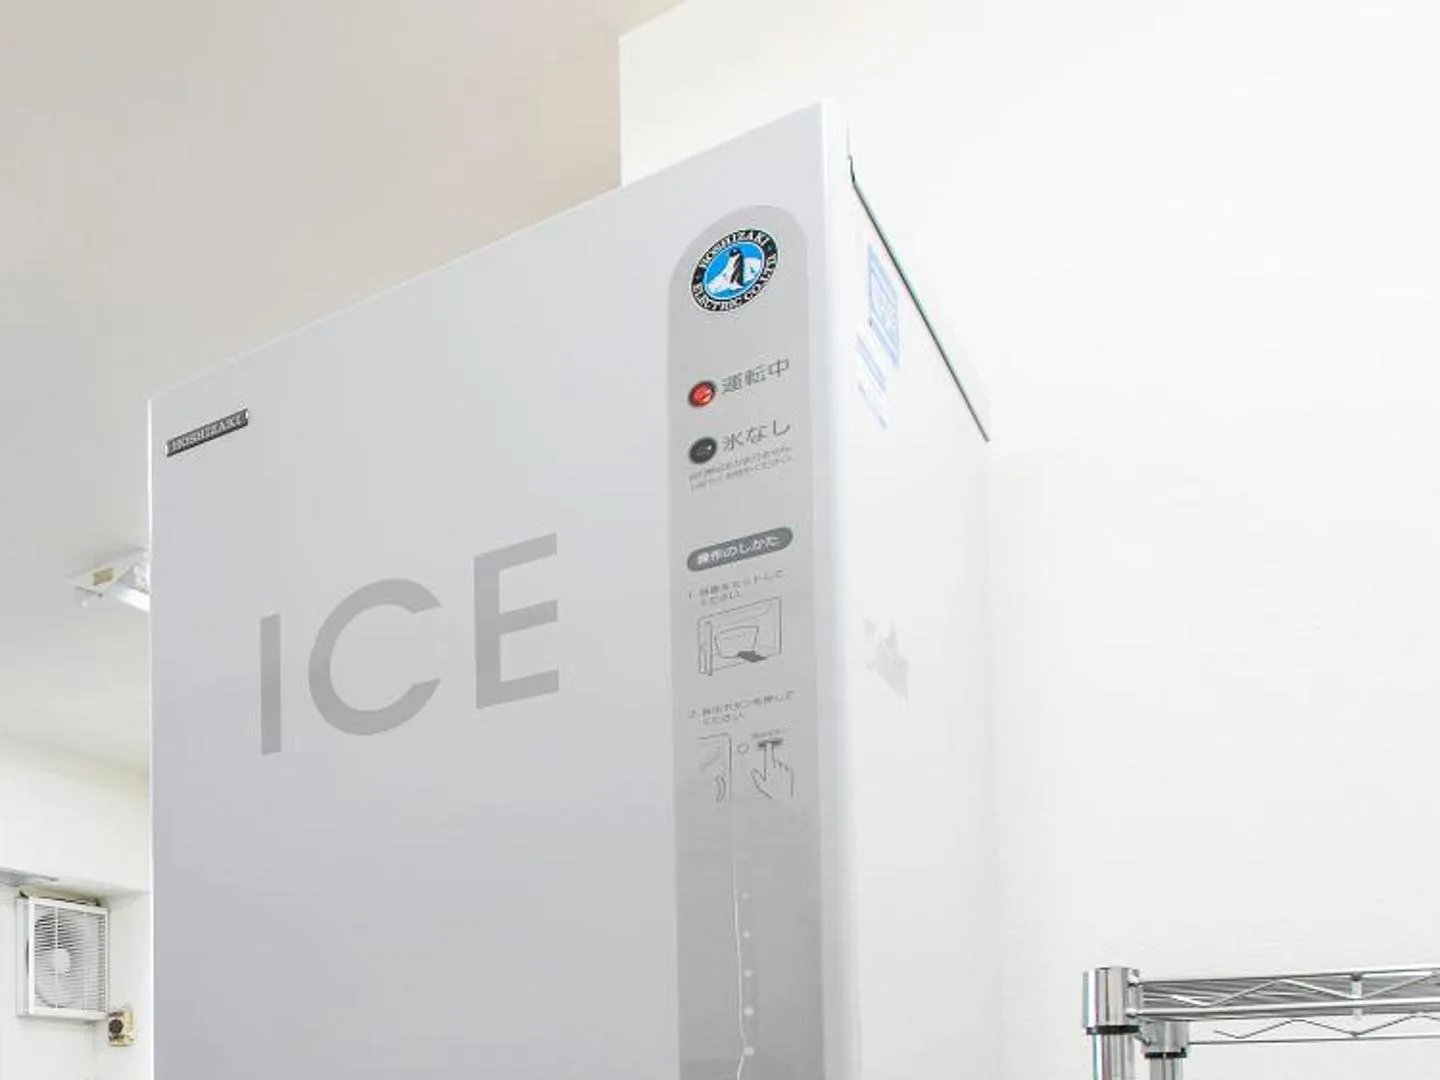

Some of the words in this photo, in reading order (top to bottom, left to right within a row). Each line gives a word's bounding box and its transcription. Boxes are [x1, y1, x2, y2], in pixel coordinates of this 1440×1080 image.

[722, 358, 790, 395] 運転中
[722, 420, 791, 451] 氷なし
[260, 532, 559, 756] ICE
